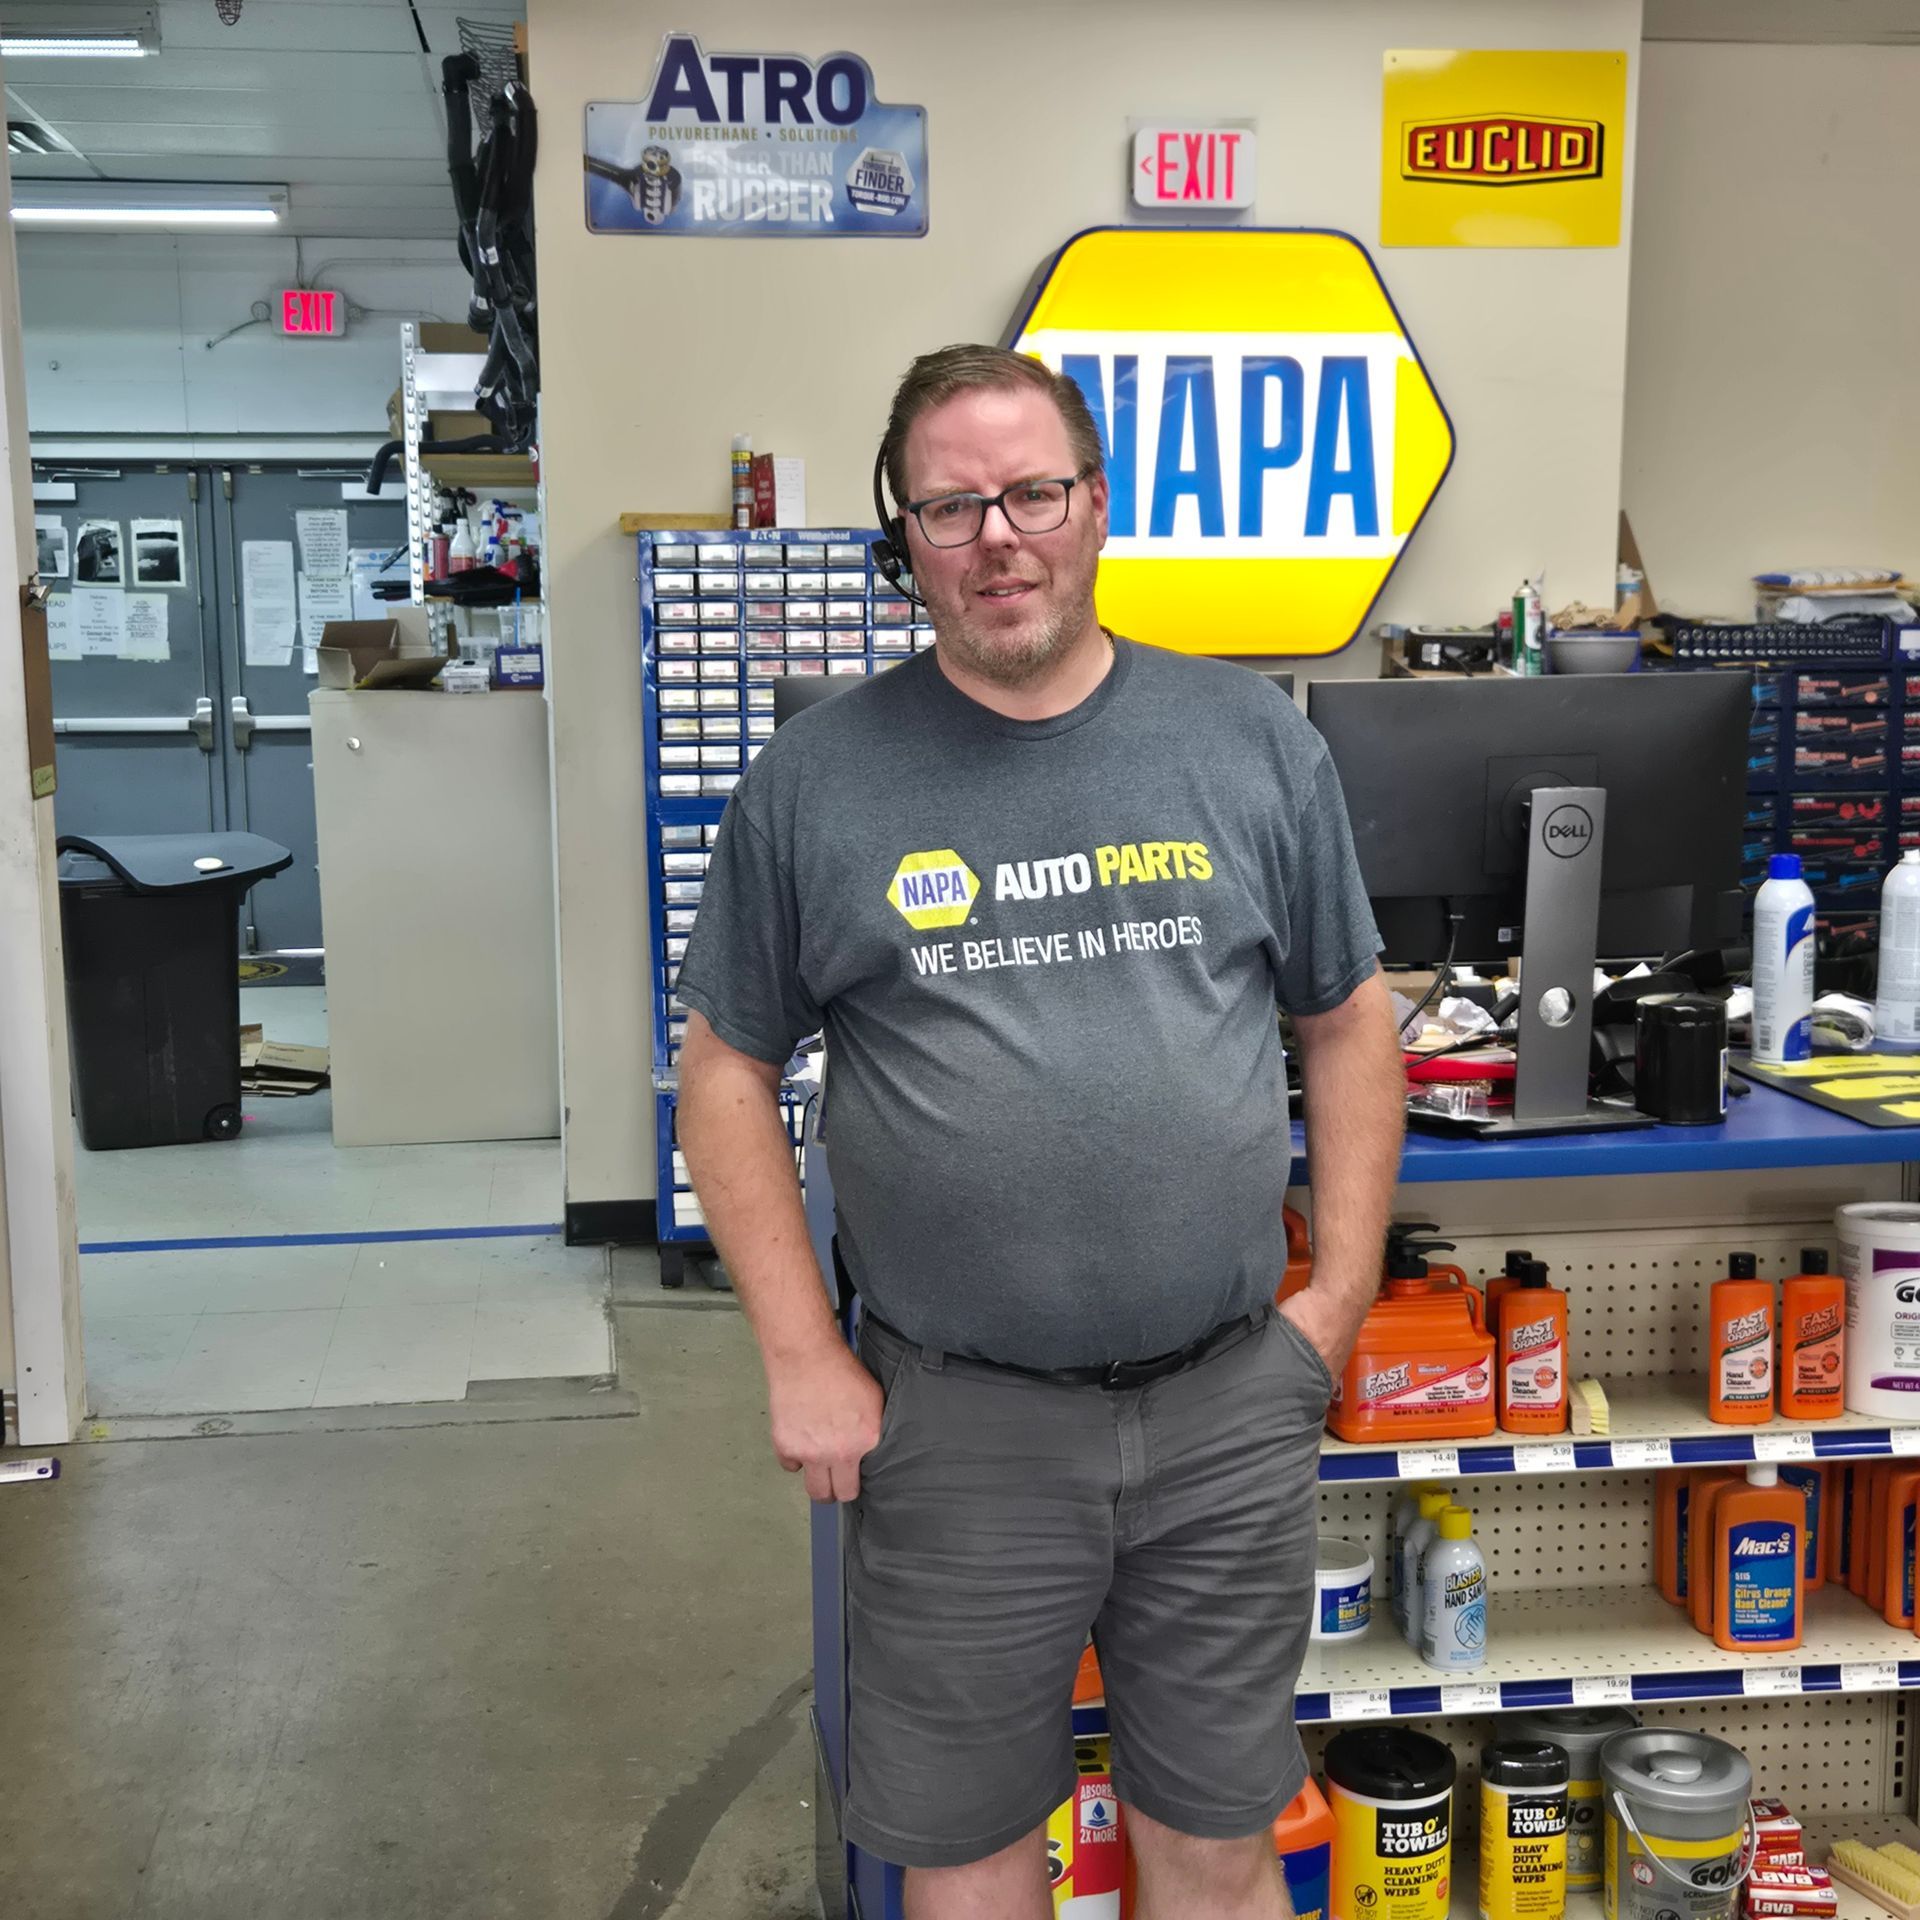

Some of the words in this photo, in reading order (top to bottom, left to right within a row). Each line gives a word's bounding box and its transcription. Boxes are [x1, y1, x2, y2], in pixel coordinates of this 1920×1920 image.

[645, 38, 867, 126] ATRO
[648, 126, 758, 141] POLYURETHANE
[779, 127, 857, 143] SOLUTIONS
[1416, 124, 1588, 173] EUCLID
[779, 151, 833, 175] THAN
[1156, 132, 1241, 200] EXIT
[855, 168, 905, 193] FINDER
[693, 177, 835, 223] RUBBER
[283, 291, 336, 333] EXIT
[1060, 353, 1380, 537] NAPA
[750, 530, 781, 540] EATON
[48, 621, 67, 629] OUR
[48, 642, 68, 650] LIPS
[1549, 825, 1588, 838] DELL
[901, 870, 968, 908] NAPA
[994, 852, 1092, 901] AUTO
[1095, 841, 1214, 887] PARTS
[911, 942, 958, 976] WE
[963, 932, 1071, 972] BELIEVE
[1077, 928, 1106, 960] IN
[1112, 916, 1203, 953] HEROES
[1727, 1307, 1767, 1334] FAST
[1802, 1304, 1838, 1329] FAST
[1513, 1316, 1555, 1342] FAST
[1727, 1322, 1767, 1342] ORANGE
[1801, 1318, 1839, 1337] ORANGE
[1513, 1331, 1556, 1351] ORANGE
[1365, 1362, 1410, 1389] FAST
[1512, 1379, 1529, 1387] Hand
[1365, 1377, 1410, 1398] ORANGE
[1645, 1442, 1669, 1452] 20.49
[1792, 1435, 1811, 1445] 4.99
[1433, 1452, 1456, 1462] 14.49
[1552, 1446, 1571, 1456] 5.99
[1734, 1536, 1790, 1556] Mac's
[1444, 1591, 1467, 1609] HAND
[1735, 1588, 1761, 1599] Citrus
[1763, 1587, 1792, 1599] Orange
[1735, 1599, 1756, 1609] Hand
[1758, 1598, 1789, 1609] Cleaner
[1780, 1670, 1799, 1679] 6.69
[1877, 1665, 1897, 1674] 5.49
[1478, 1686, 1497, 1695] 3.29
[1606, 1679, 1630, 1688] 19.99
[1369, 1693, 1388, 1702] 8.49
[1079, 1783, 1117, 1800] ABSORB
[1512, 1808, 1545, 1820] TUB
[1382, 1822, 1423, 1838] TUB
[1512, 1816, 1566, 1834] TOWELS
[1079, 1828, 1092, 1844] 2X
[1092, 1826, 1118, 1843] MORE
[1382, 1825, 1448, 1853] TOWELS
[1513, 1844, 1549, 1854] HEAVY
[1384, 1865, 1423, 1876] HEAVY
[1425, 1854, 1446, 1872] DUTY
[1513, 1855, 1542, 1864] DUTY
[1513, 1861, 1564, 1874] CLEANING
[1384, 1870, 1439, 1886] CLEANING
[1512, 1874, 1546, 1884] WIPES
[1690, 1856, 1741, 1886] GOJO
[1749, 1869, 1814, 1885] Lava
[1384, 1887, 1421, 1897] WIPES
[1754, 1898, 1794, 1914] Lava
